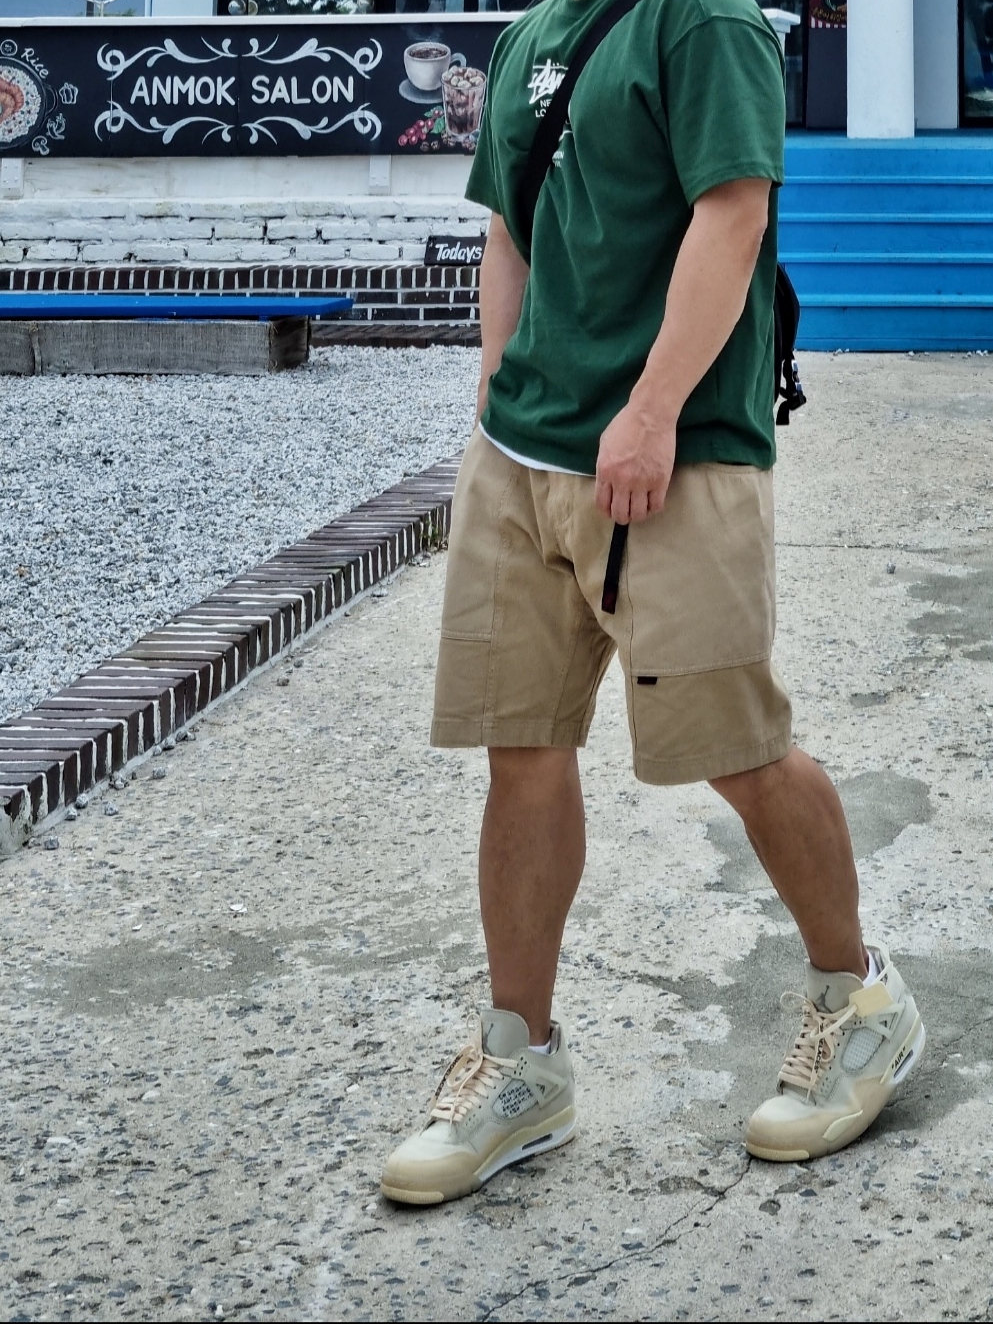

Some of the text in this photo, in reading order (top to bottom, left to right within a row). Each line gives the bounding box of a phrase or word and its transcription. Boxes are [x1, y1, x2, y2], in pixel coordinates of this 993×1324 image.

[20, 47, 49, 79] Rice
[130, 75, 354, 106] ANMOK SALON
[435, 241, 483, 264] Todays
